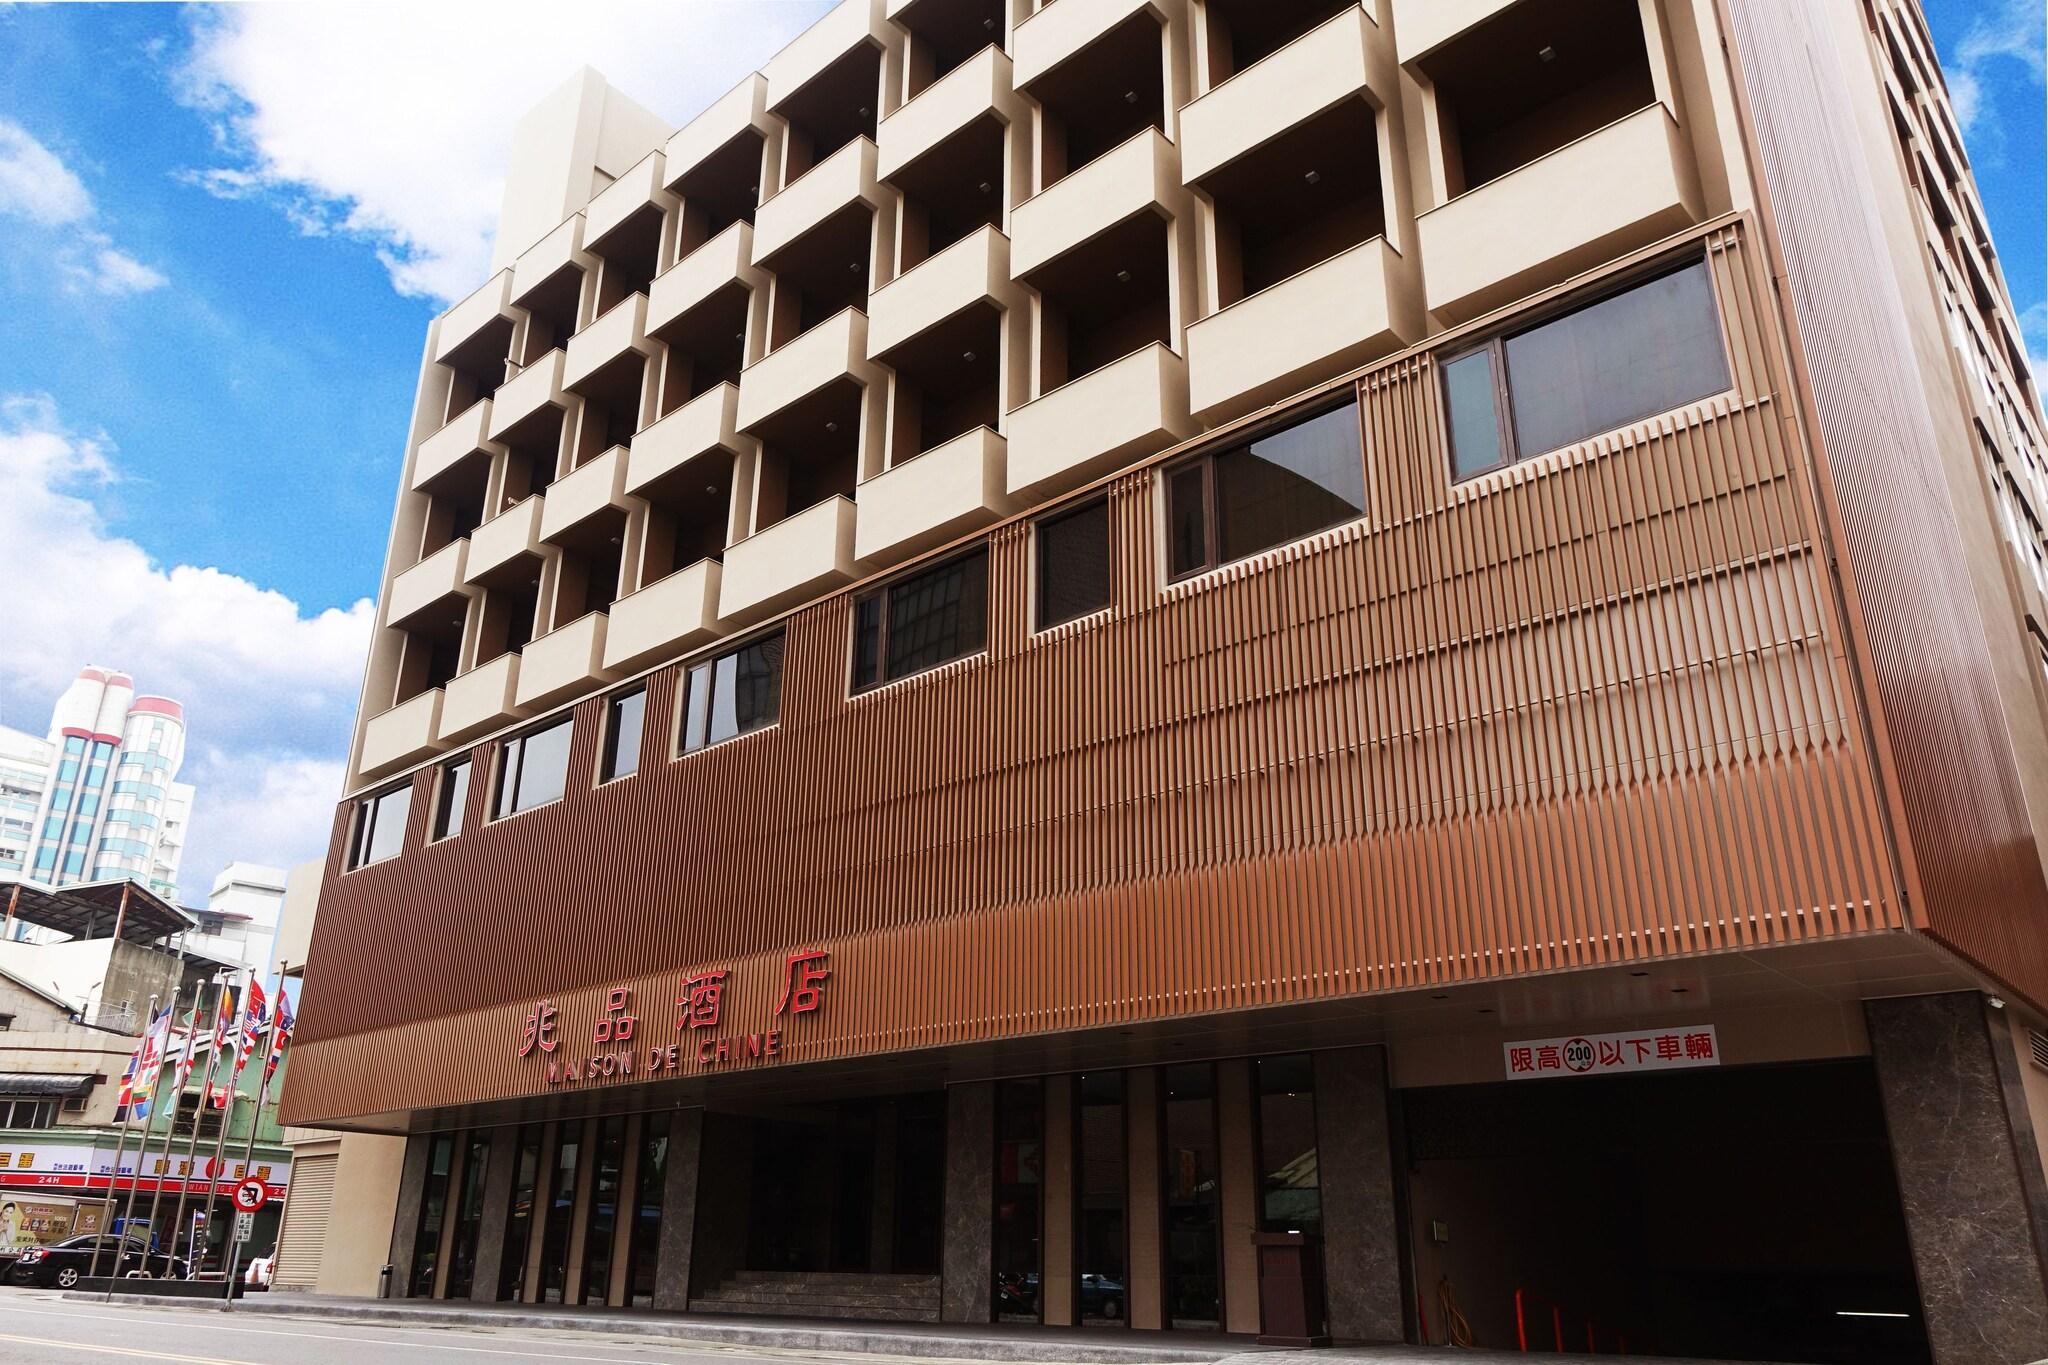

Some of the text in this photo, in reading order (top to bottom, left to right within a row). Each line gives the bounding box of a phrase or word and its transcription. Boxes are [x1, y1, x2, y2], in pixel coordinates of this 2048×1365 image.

[519, 946, 832, 1056] 兆品酒店
[648, 1043, 678, 1071] DE
[697, 1029, 780, 1063] CHINE
[1510, 1046, 1561, 1073] 限高
[1567, 1046, 1591, 1062] 200
[1599, 1033, 1713, 1066] 以下車輛
[38, 1176, 60, 1184] 24H
